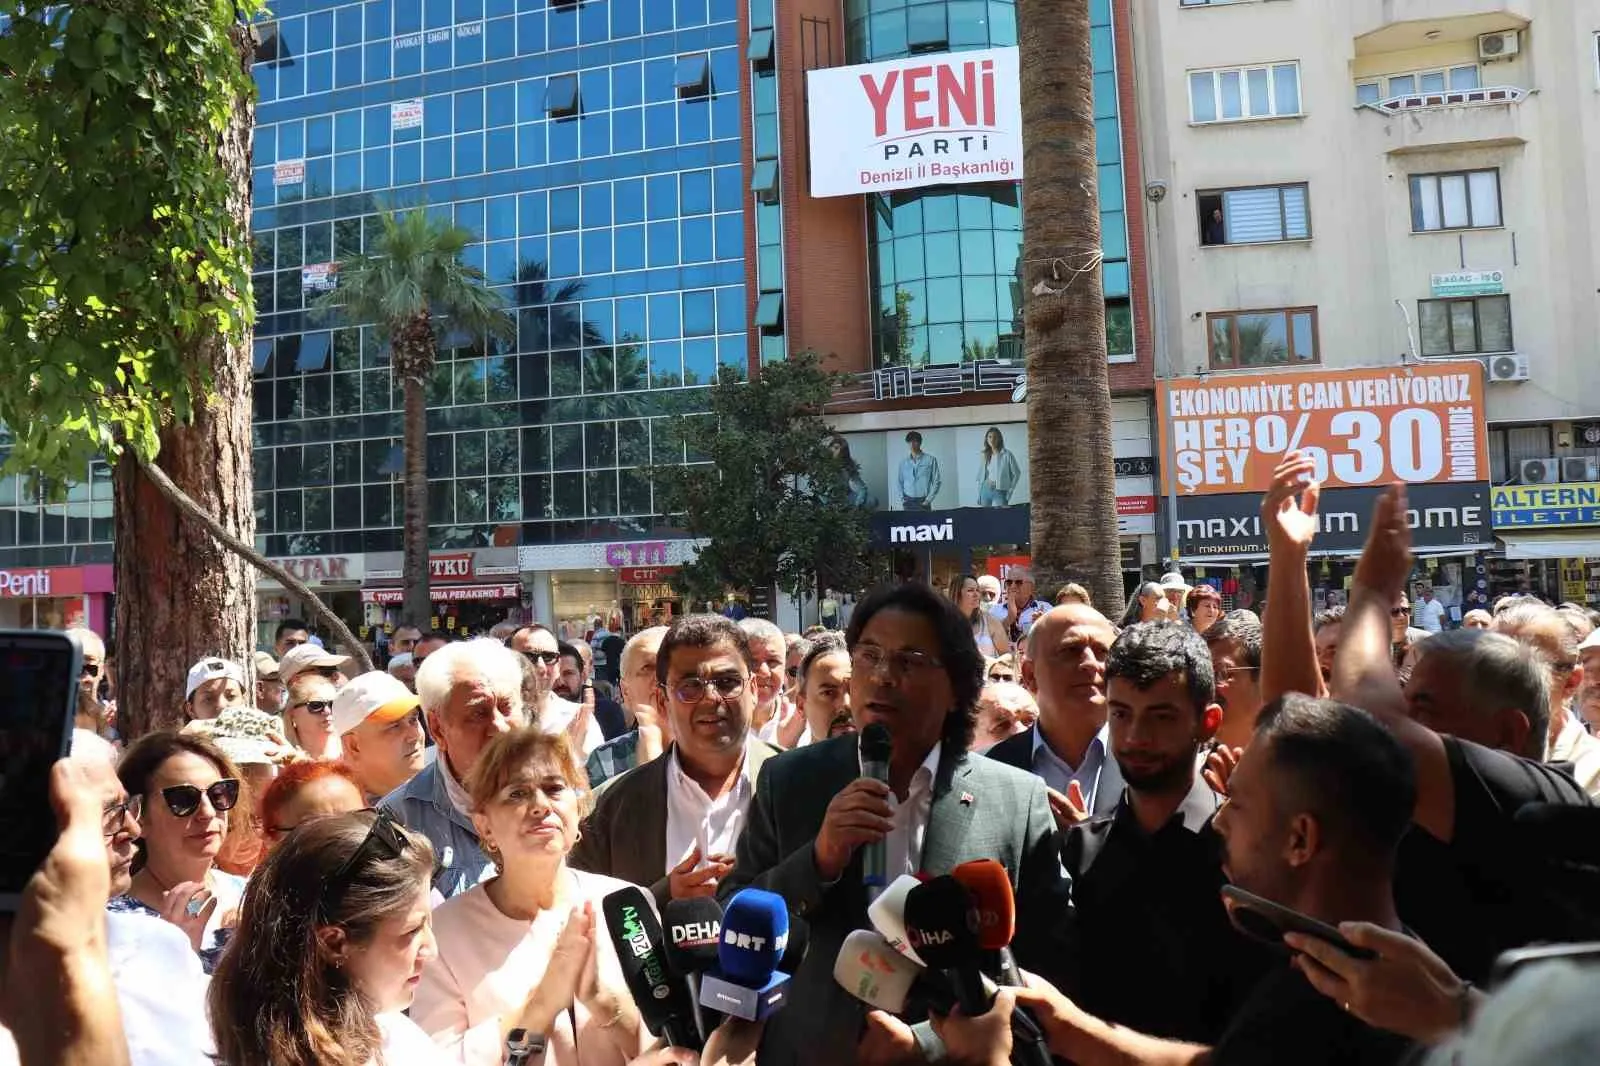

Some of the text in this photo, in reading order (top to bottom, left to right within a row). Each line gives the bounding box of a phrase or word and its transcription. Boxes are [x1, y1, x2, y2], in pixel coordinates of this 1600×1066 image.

[859, 60, 996, 137] YENİ
[884, 135, 989, 160] PARTİ
[860, 164, 913, 185] Denizli
[931, 158, 1014, 178] Başkanlığı
[1170, 372, 1472, 416] EKONOMİYE CAN VERİYORUZ
[1174, 418, 1251, 450] HER
[1176, 449, 1249, 493] ŞEY
[1494, 486, 1600, 508] ALTERN
[1404, 506, 1482, 528] OME
[890, 518, 953, 542] mavi
[428, 559, 470, 576] TKU
[0, 569, 50, 595] Penti
[671, 920, 721, 944] DEHA
[724, 929, 767, 951] DRT
